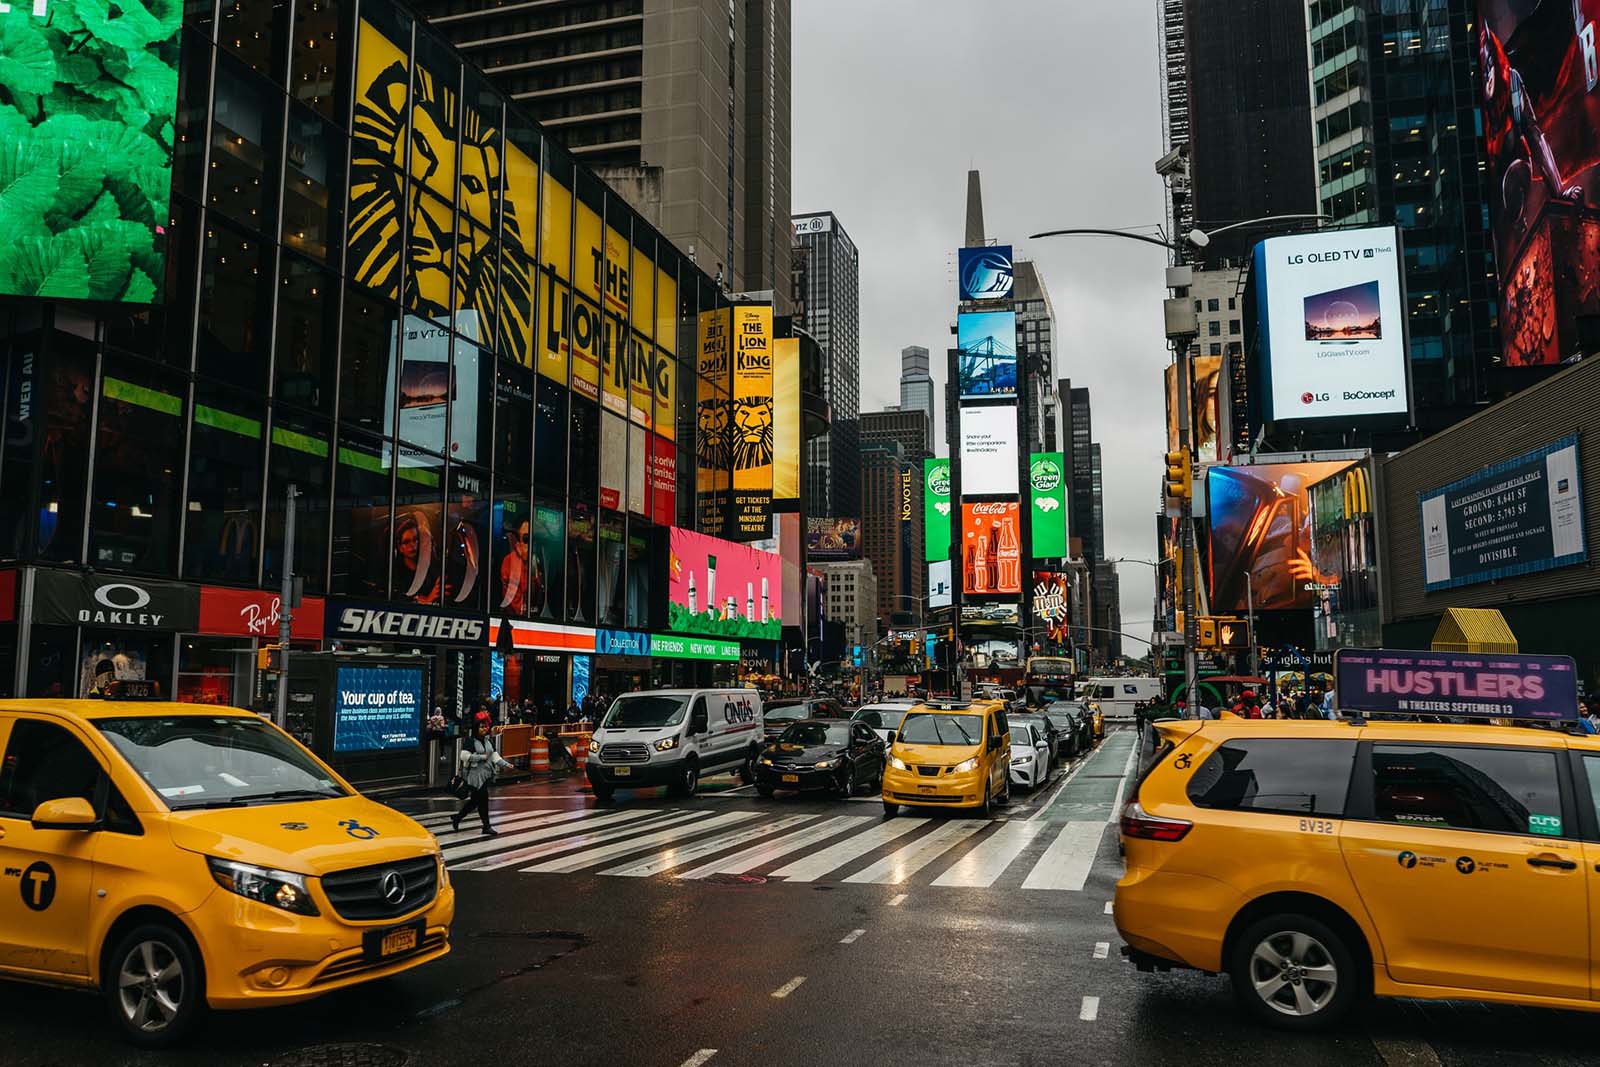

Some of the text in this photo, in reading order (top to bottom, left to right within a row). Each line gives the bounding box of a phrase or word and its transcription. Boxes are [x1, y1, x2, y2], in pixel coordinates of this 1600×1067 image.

[1288, 255, 1304, 265] LG
[1308, 251, 1341, 263] OLED
[1343, 250, 1360, 260] TV
[1363, 249, 1374, 258] AI
[592, 246, 628, 304] THE
[742, 323, 763, 332] THE
[739, 335, 766, 350] LION
[614, 311, 669, 400] KING
[737, 352, 770, 371] KING
[1315, 389, 1396, 402] LG BoConcept
[1032, 474, 1058, 482] Green
[1036, 480, 1059, 490] Giant
[902, 469, 911, 521] NOVOTEL
[1463, 499, 1495, 517] GROUND:
[1518, 487, 1527, 499] SF
[738, 515, 767, 523] MINSKOFF
[1464, 513, 1496, 530] SECOND:
[1518, 503, 1527, 515] SF
[1479, 546, 1518, 564] DIVISIBLE
[78, 609, 163, 626] OAKLEY
[338, 608, 484, 641] SKECHERS
[610, 638, 641, 649] COLLECTION
[661, 641, 684, 653] FRIENDS
[690, 644, 702, 654] NEW
[703, 645, 716, 655] YORK
[543, 655, 561, 663] TISSOT
[1313, 653, 1333, 664] hut
[456, 651, 465, 720] SKECHERS
[1366, 669, 1544, 700] HUSTLERS
[342, 690, 415, 707] Your cup of tea.
[1398, 700, 1513, 714] IN THEATERS SEPTEMBER 13
[1300, 819, 1333, 834] BV32
[1529, 815, 1561, 827] curb
